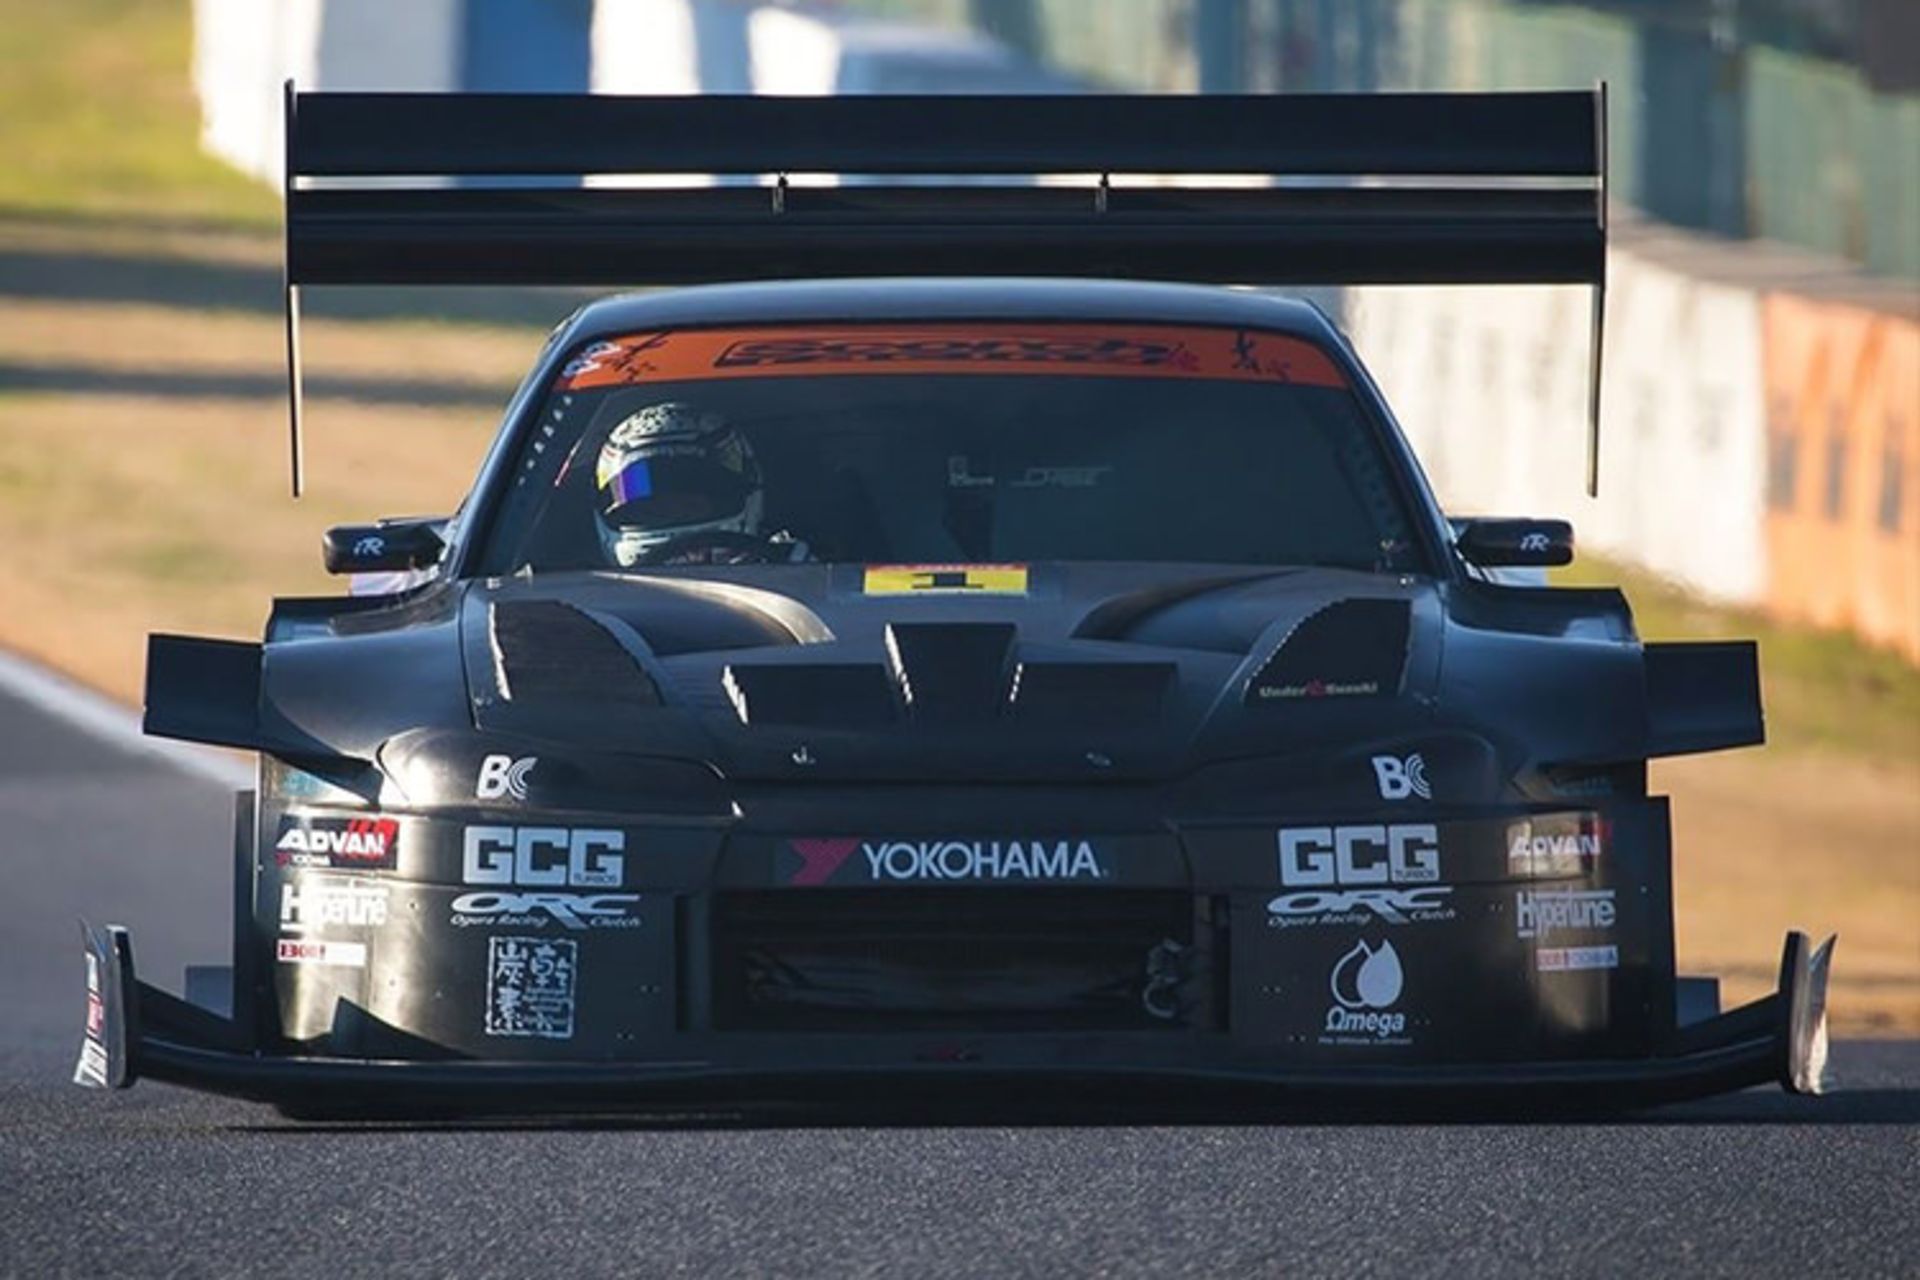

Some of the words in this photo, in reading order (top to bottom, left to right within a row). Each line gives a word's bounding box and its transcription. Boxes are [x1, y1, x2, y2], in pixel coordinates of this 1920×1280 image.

[275, 829, 386, 855] ADVAN
[463, 826, 625, 887] GCG
[862, 840, 1101, 880] YOKOHAMA
[1279, 824, 1440, 886] GCG
[1509, 835, 1601, 858] ADVAN
